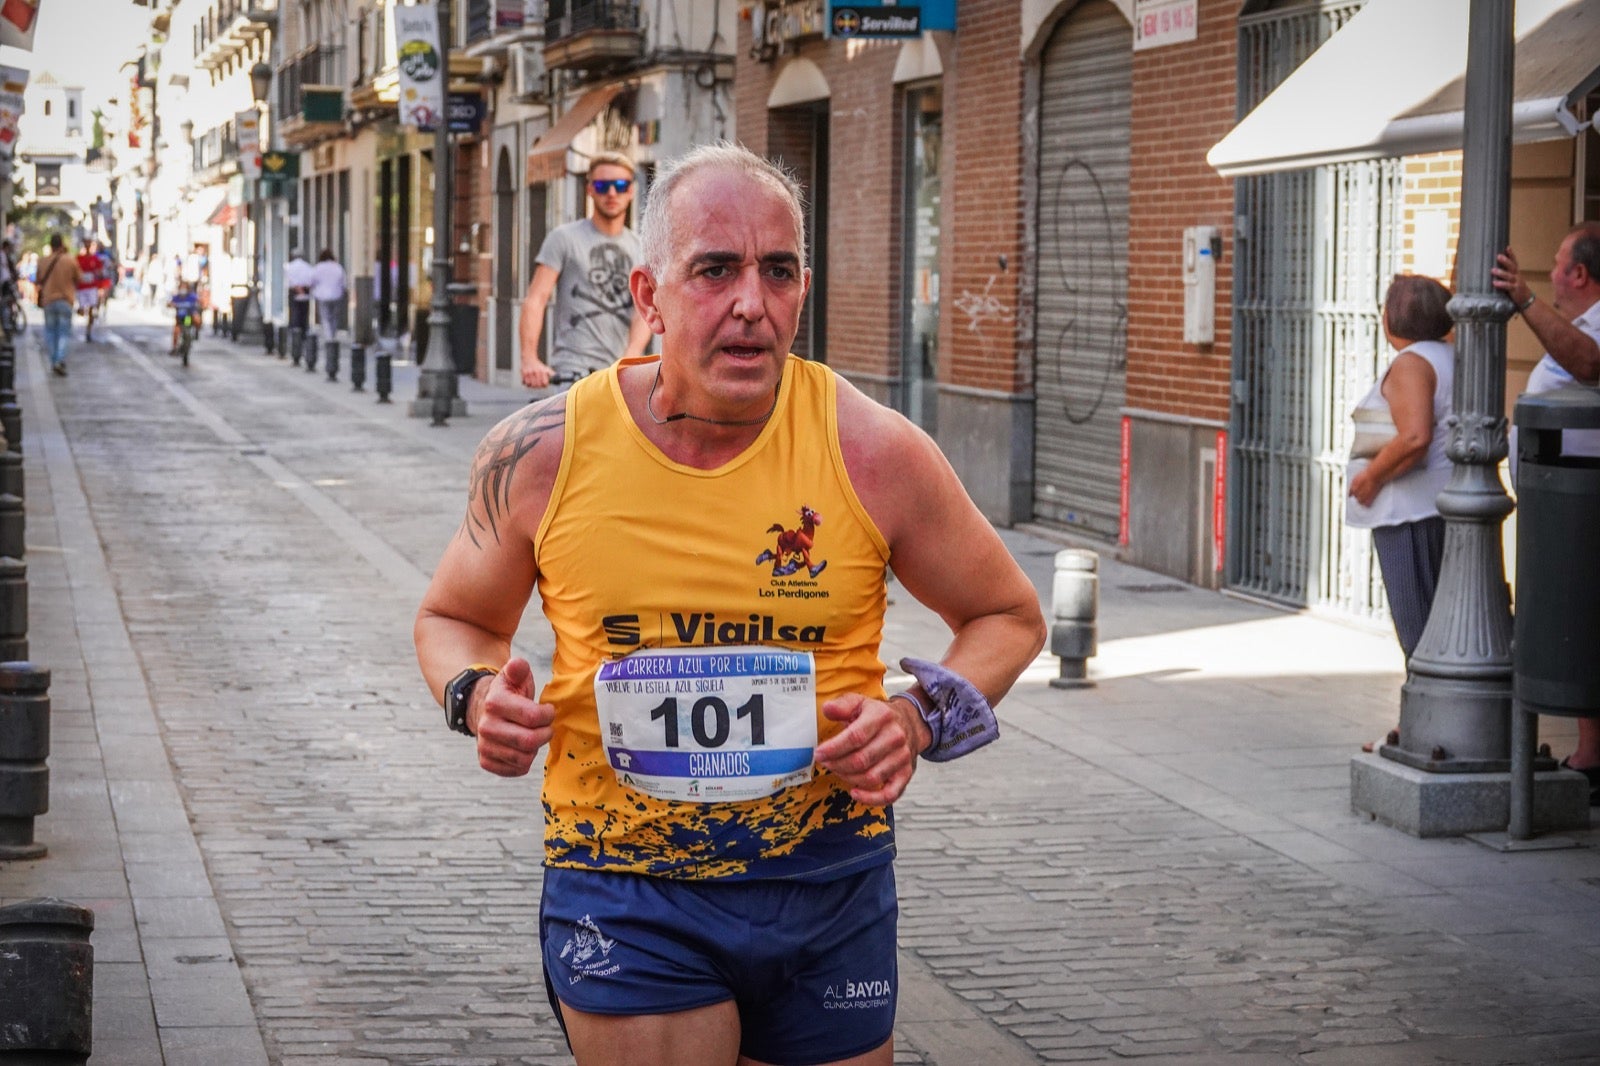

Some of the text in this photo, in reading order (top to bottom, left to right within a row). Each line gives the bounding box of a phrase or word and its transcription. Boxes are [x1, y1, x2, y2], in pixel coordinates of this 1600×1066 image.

[759, 588, 829, 599] Los Perdigones
[626, 658, 673, 675] CARRERA
[678, 657, 705, 674] AZUL
[710, 656, 731, 674] POR
[736, 655, 748, 672] EL
[753, 654, 799, 671] AUTISMO
[606, 681, 631, 693] VUELVE
[633, 681, 643, 694] LA
[645, 680, 671, 694] ESTELA
[675, 680, 692, 693] AZUL
[650, 693, 765, 749] 101
[689, 751, 751, 777] GRANADOS
[823, 978, 891, 999] AL BAYDA
